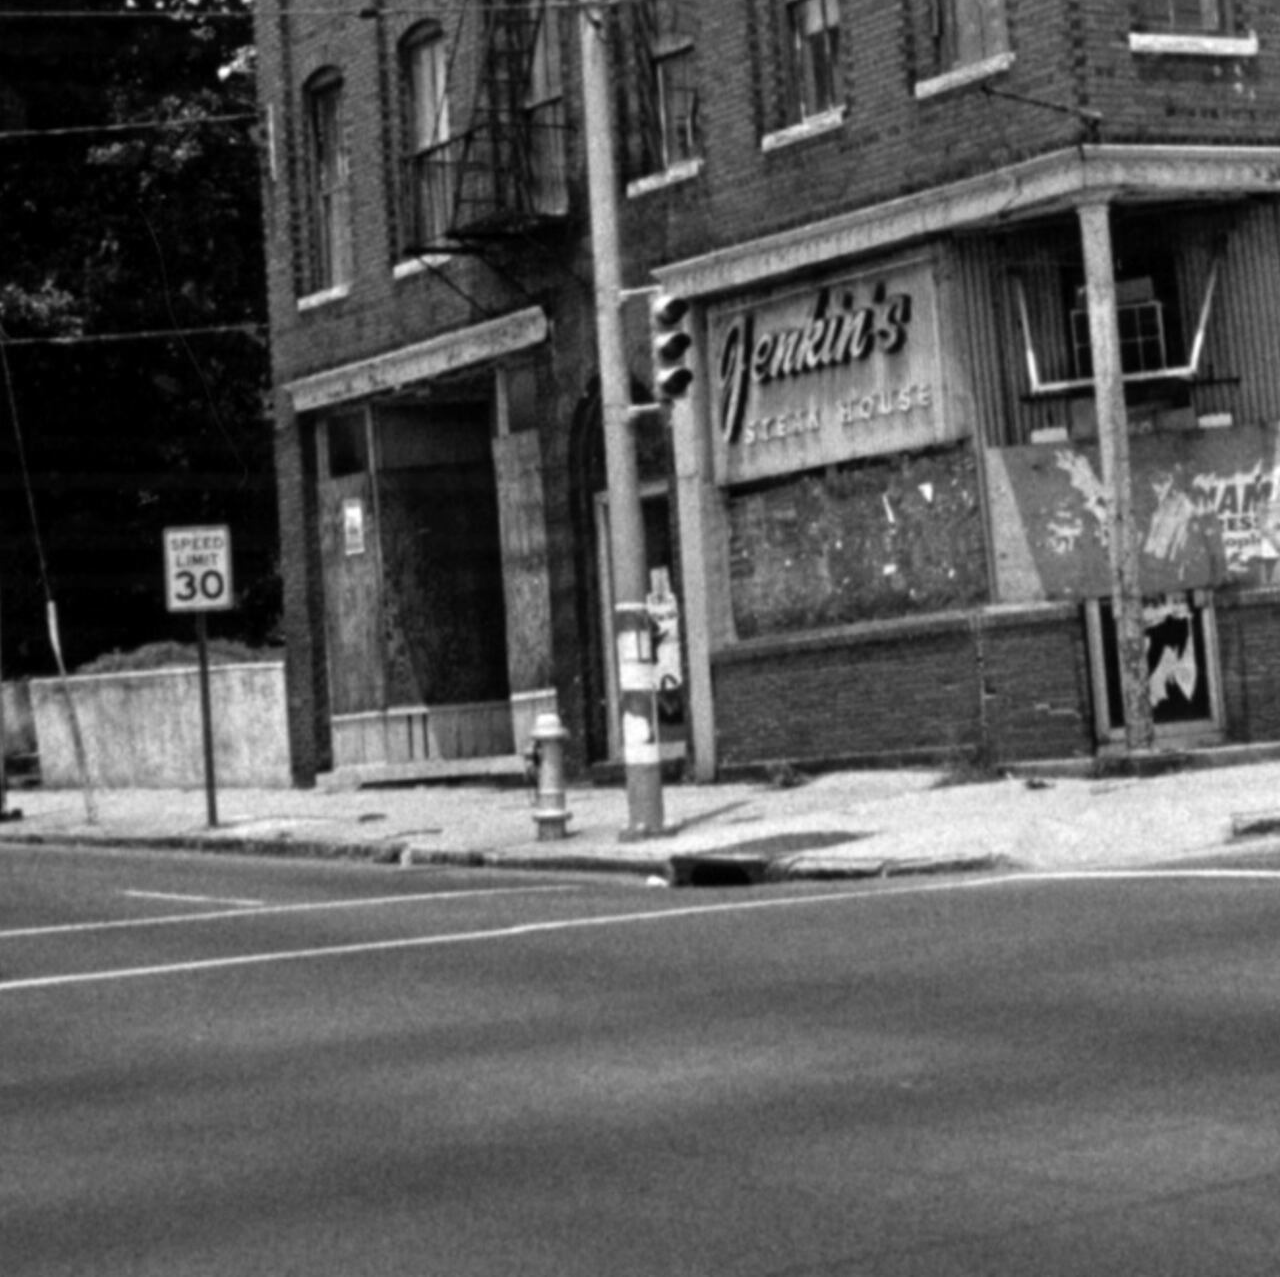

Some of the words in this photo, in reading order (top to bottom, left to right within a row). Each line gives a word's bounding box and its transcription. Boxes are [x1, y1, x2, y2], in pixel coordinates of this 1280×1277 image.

[720, 281, 911, 444] Jenkin's
[743, 409, 819, 444] STEAK
[837, 384, 932, 422] HOUSE
[171, 536, 224, 551] SPEED
[176, 552, 219, 568] LIMIT
[175, 569, 224, 601] 30
